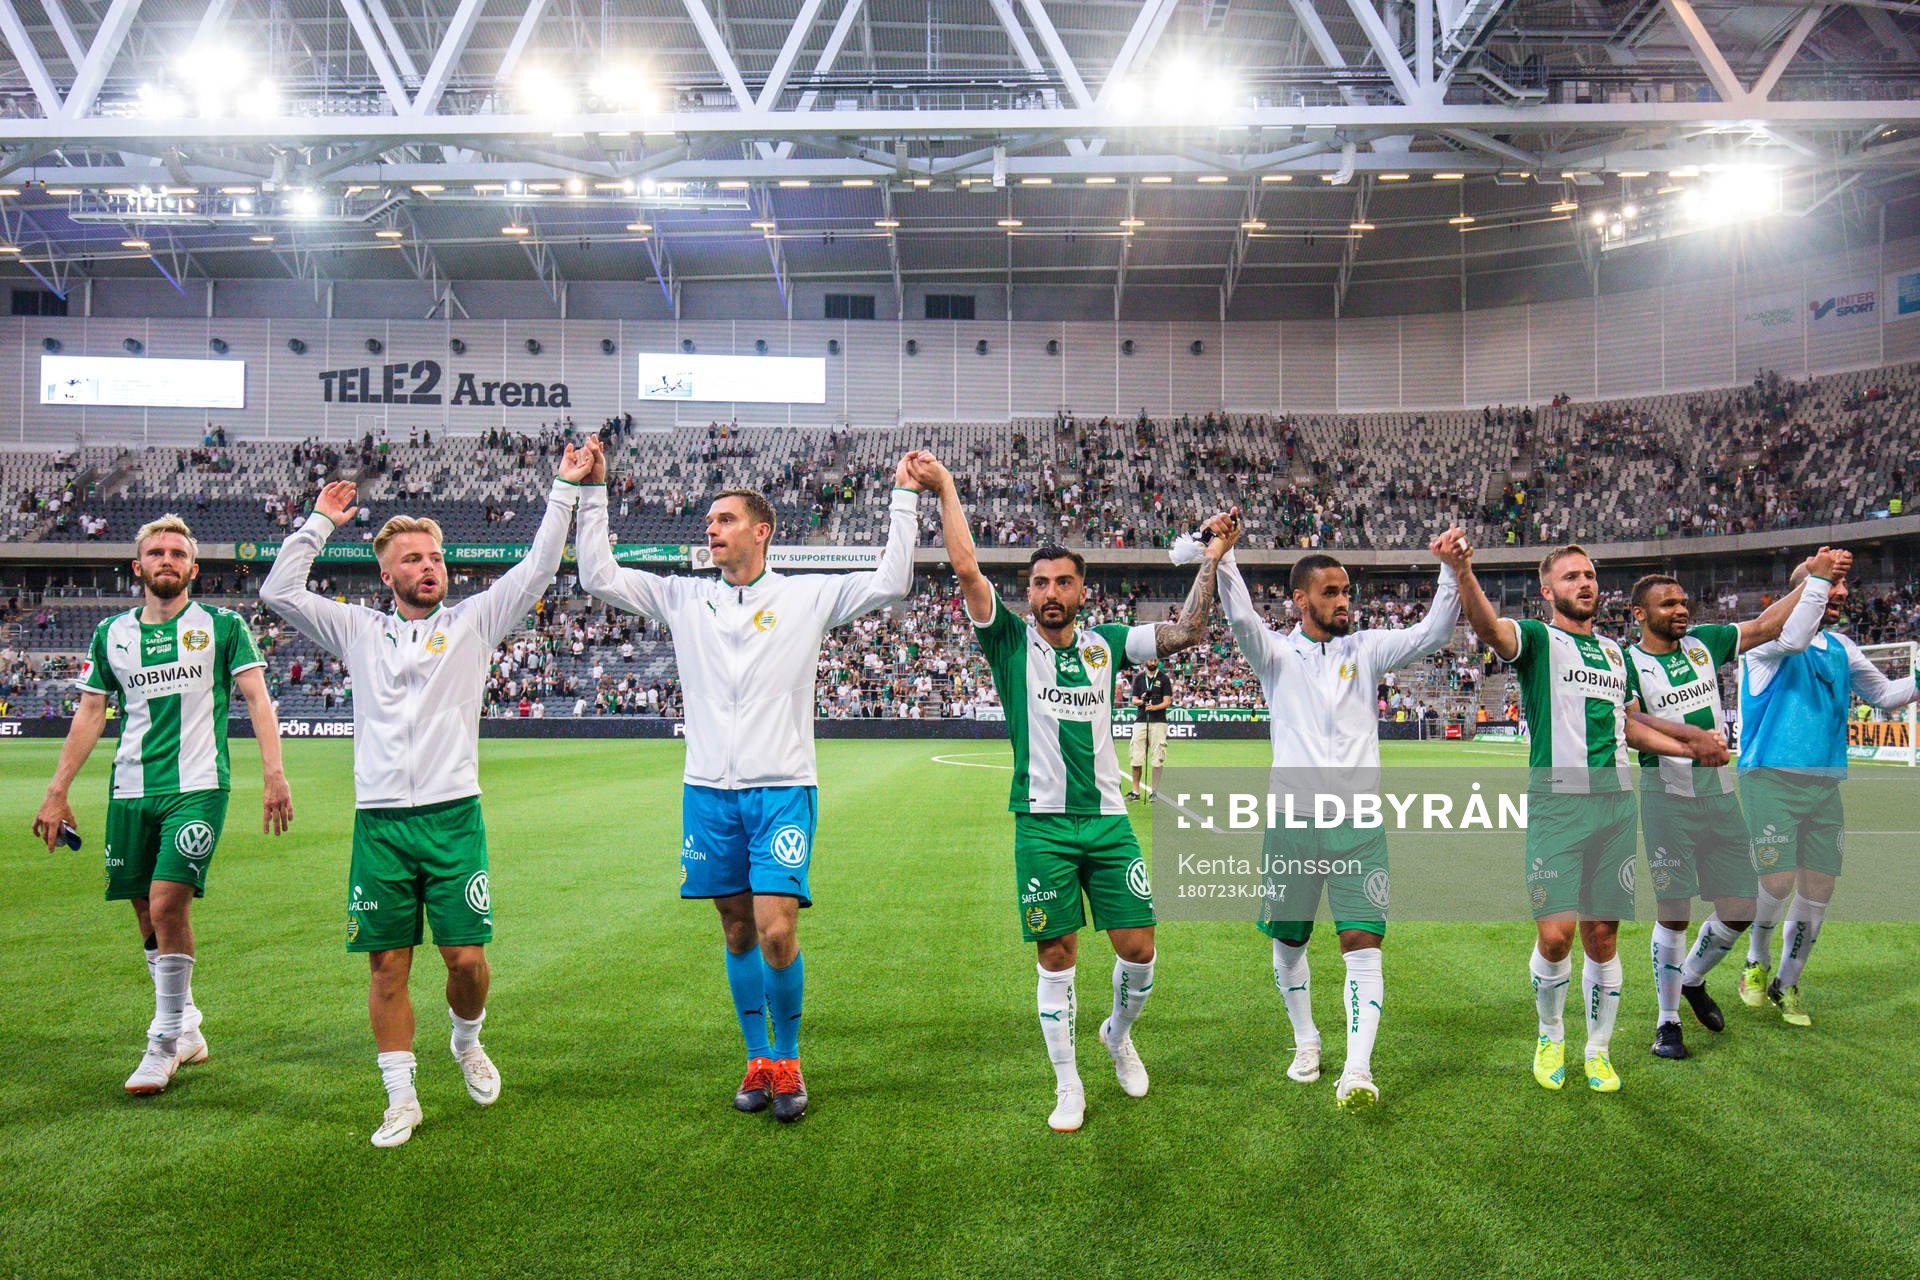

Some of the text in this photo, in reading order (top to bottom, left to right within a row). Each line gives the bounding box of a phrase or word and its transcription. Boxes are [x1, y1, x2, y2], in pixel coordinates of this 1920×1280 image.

[1837, 292, 1874, 306] INTER
[1837, 302, 1875, 317] SPORT
[319, 360, 572, 408] TELE2 Arena
[328, 547, 372, 557] FOTBOLL
[456, 548, 505, 558] RESPEKT
[789, 554, 877, 562] SUPPORTERKULTUR
[127, 664, 203, 689] JOBMAN
[1563, 669, 1627, 692] JOBMAN
[1037, 687, 1105, 706] JOBMAN
[1658, 678, 1717, 708] JOBMAN
[279, 720, 310, 735] FÖR
[1021, 890, 1058, 904] SAFECON
[1349, 980, 1360, 1034] KVARNEN
